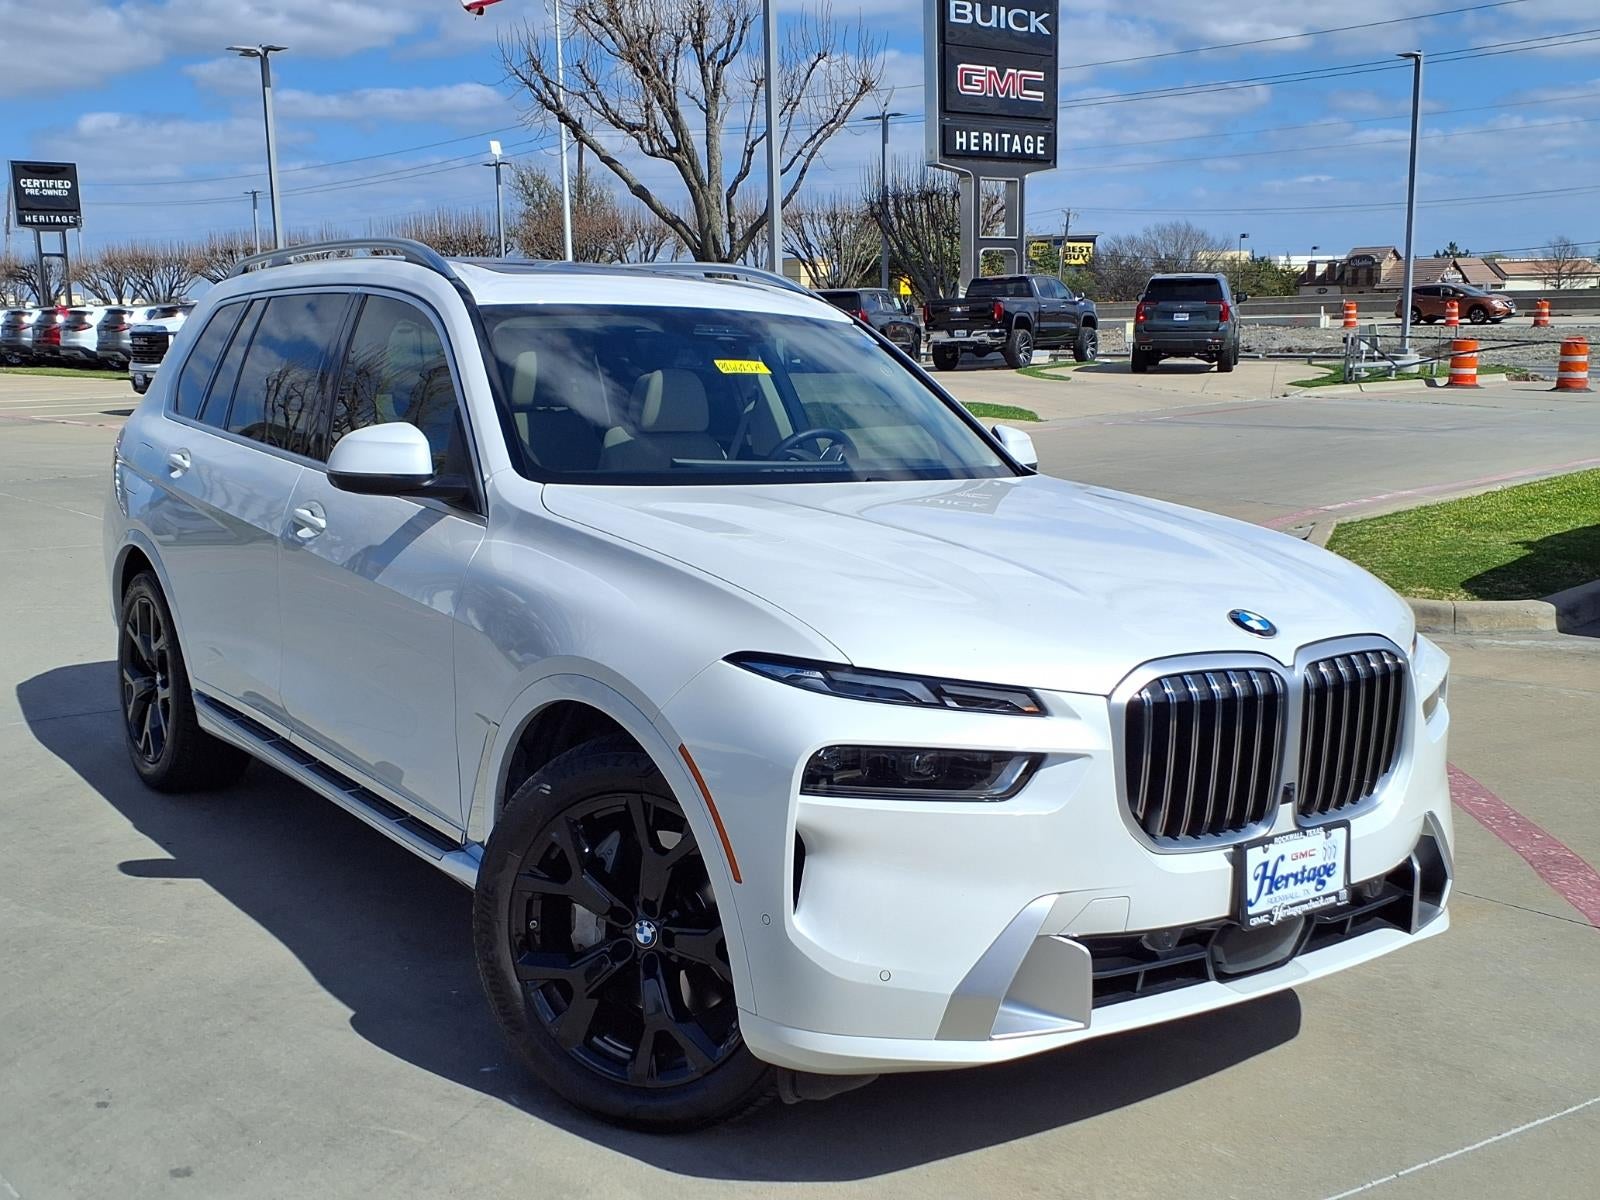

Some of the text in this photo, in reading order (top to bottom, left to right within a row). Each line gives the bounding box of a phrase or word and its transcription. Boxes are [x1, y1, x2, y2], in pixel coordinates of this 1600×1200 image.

[949, 1, 1051, 35] BUICK
[957, 63, 1045, 102] GMC
[955, 130, 1045, 155] HERITAGE
[20, 178, 72, 189] CERTIFIED
[25, 188, 69, 197] PRE-OWNED
[24, 214, 75, 223] HERITAGE
[1065, 245, 1091, 253] BEST
[1064, 253, 1088, 261] BUY
[1291, 849, 1316, 861] GMC
[1247, 854, 1337, 908] Heritage
[1249, 914, 1270, 926] GMC
